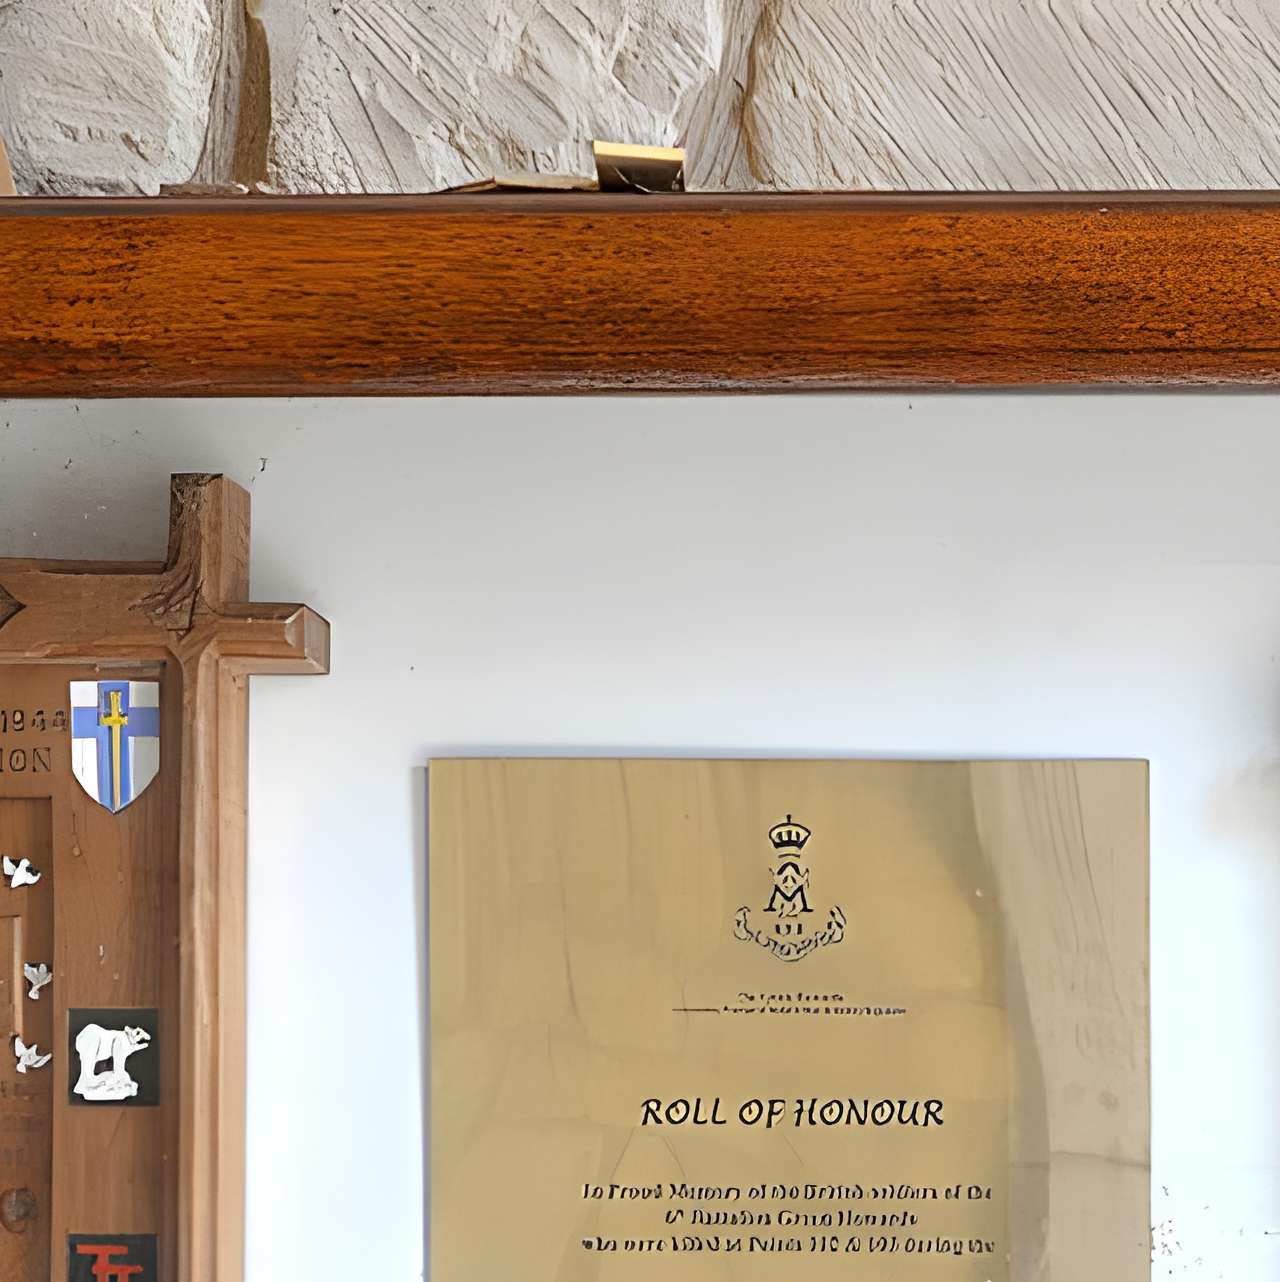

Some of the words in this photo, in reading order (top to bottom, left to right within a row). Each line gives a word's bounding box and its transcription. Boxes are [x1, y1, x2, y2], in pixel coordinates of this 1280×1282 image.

[642, 1098, 727, 1126] ROLL
[738, 1098, 786, 1128] OF
[794, 1098, 945, 1128] HONOUR
